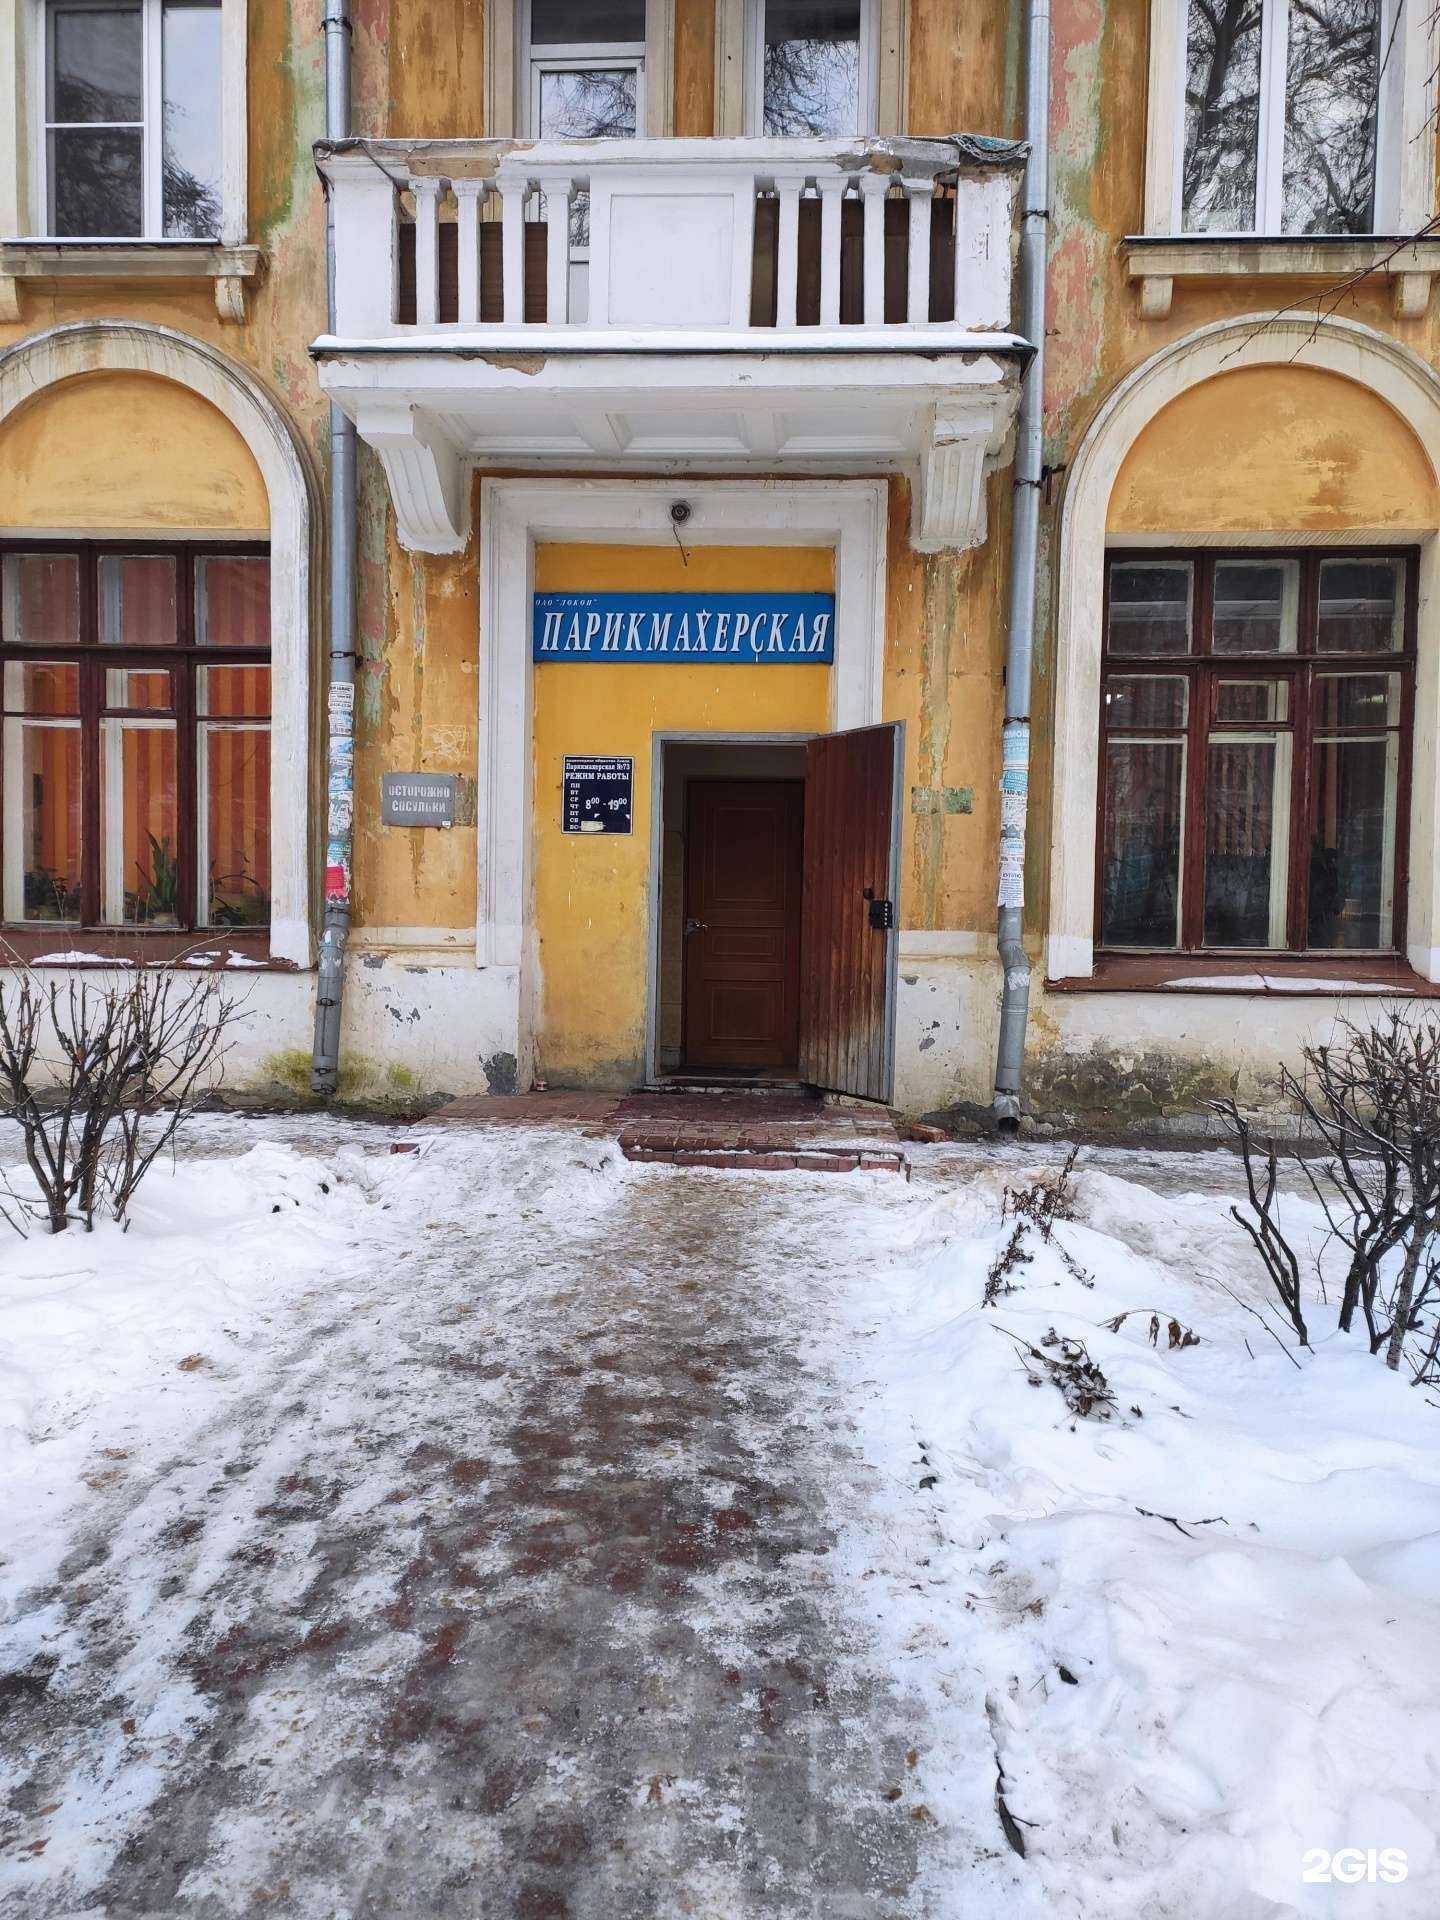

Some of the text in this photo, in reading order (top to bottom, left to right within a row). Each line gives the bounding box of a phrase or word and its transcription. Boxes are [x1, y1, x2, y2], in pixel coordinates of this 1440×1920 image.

[540, 611, 831, 653] ПАРИКМАХЕРСКАЯ
[566, 763, 615, 771] Парикмахерская
[389, 785, 450, 798] ОСТОРОЖНО
[392, 800, 446, 812] СОСУЛЬКИ
